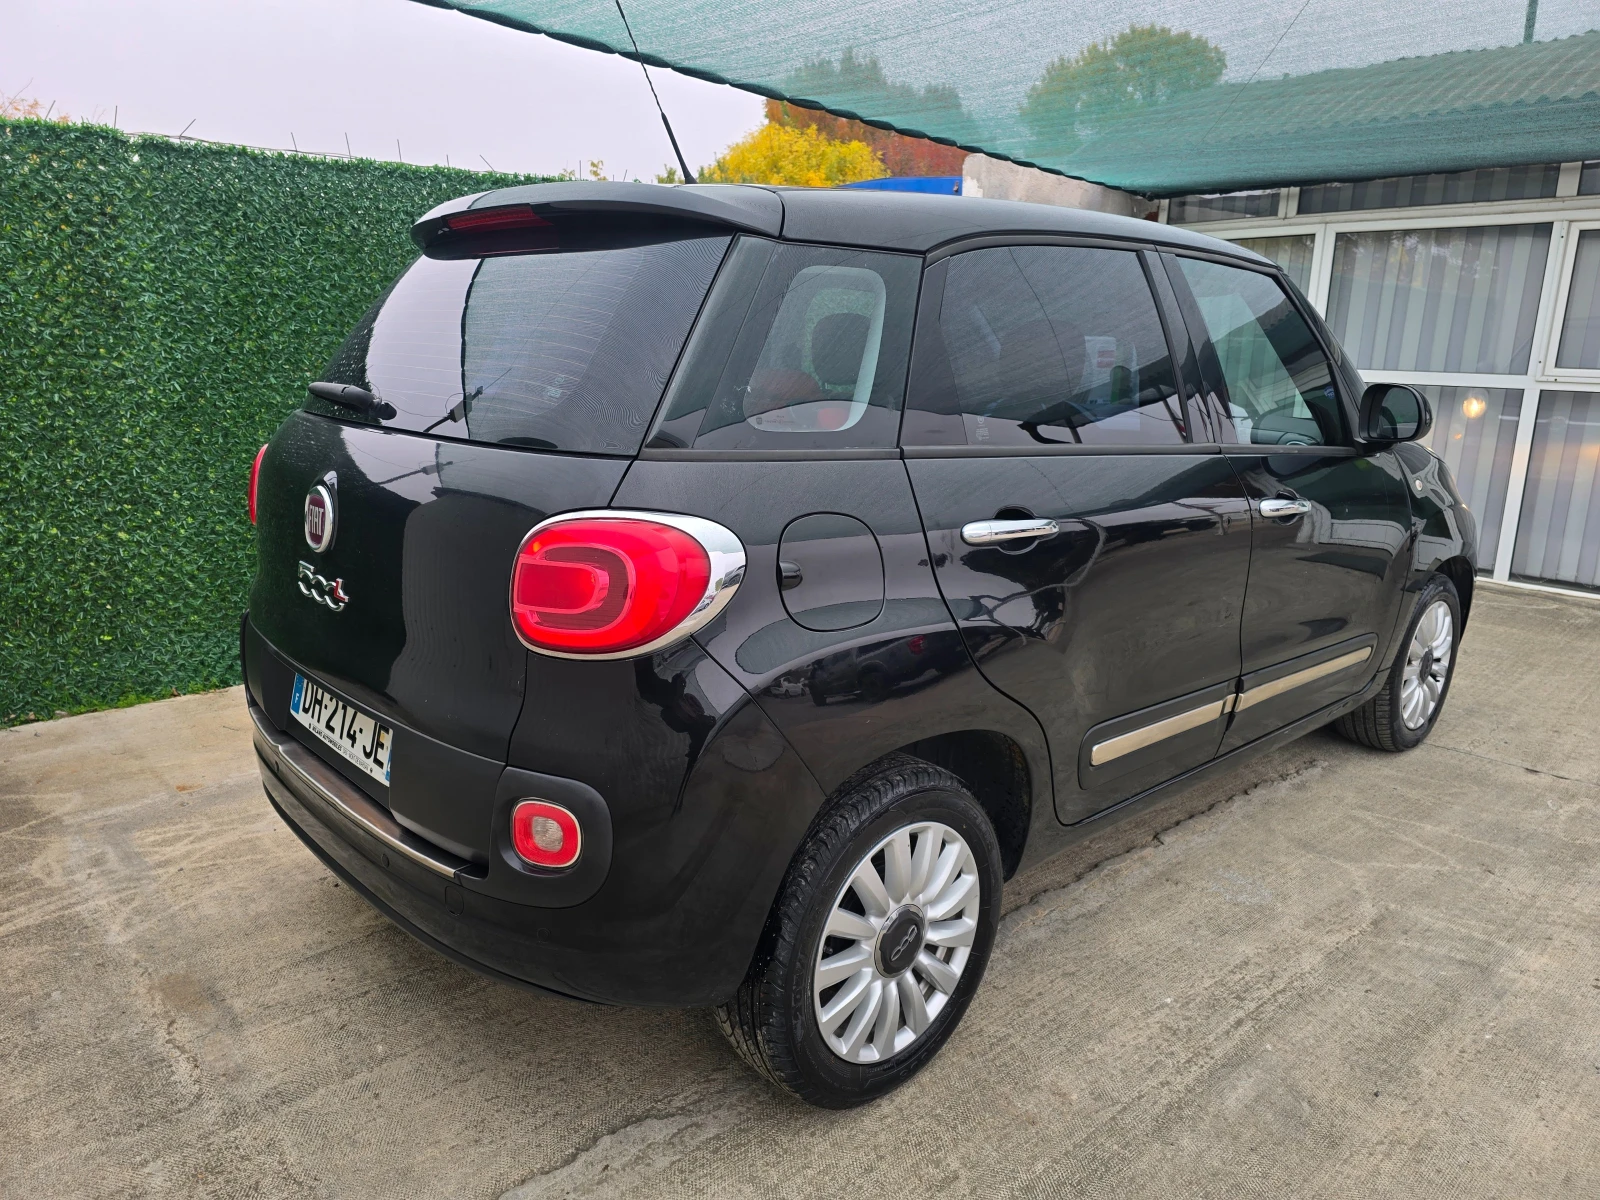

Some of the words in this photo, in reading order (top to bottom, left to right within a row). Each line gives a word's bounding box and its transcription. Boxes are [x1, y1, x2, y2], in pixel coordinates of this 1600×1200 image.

[308, 504, 324, 536] FIAT
[298, 560, 349, 612] 500L
[302, 680, 390, 770] DH-214-JE
